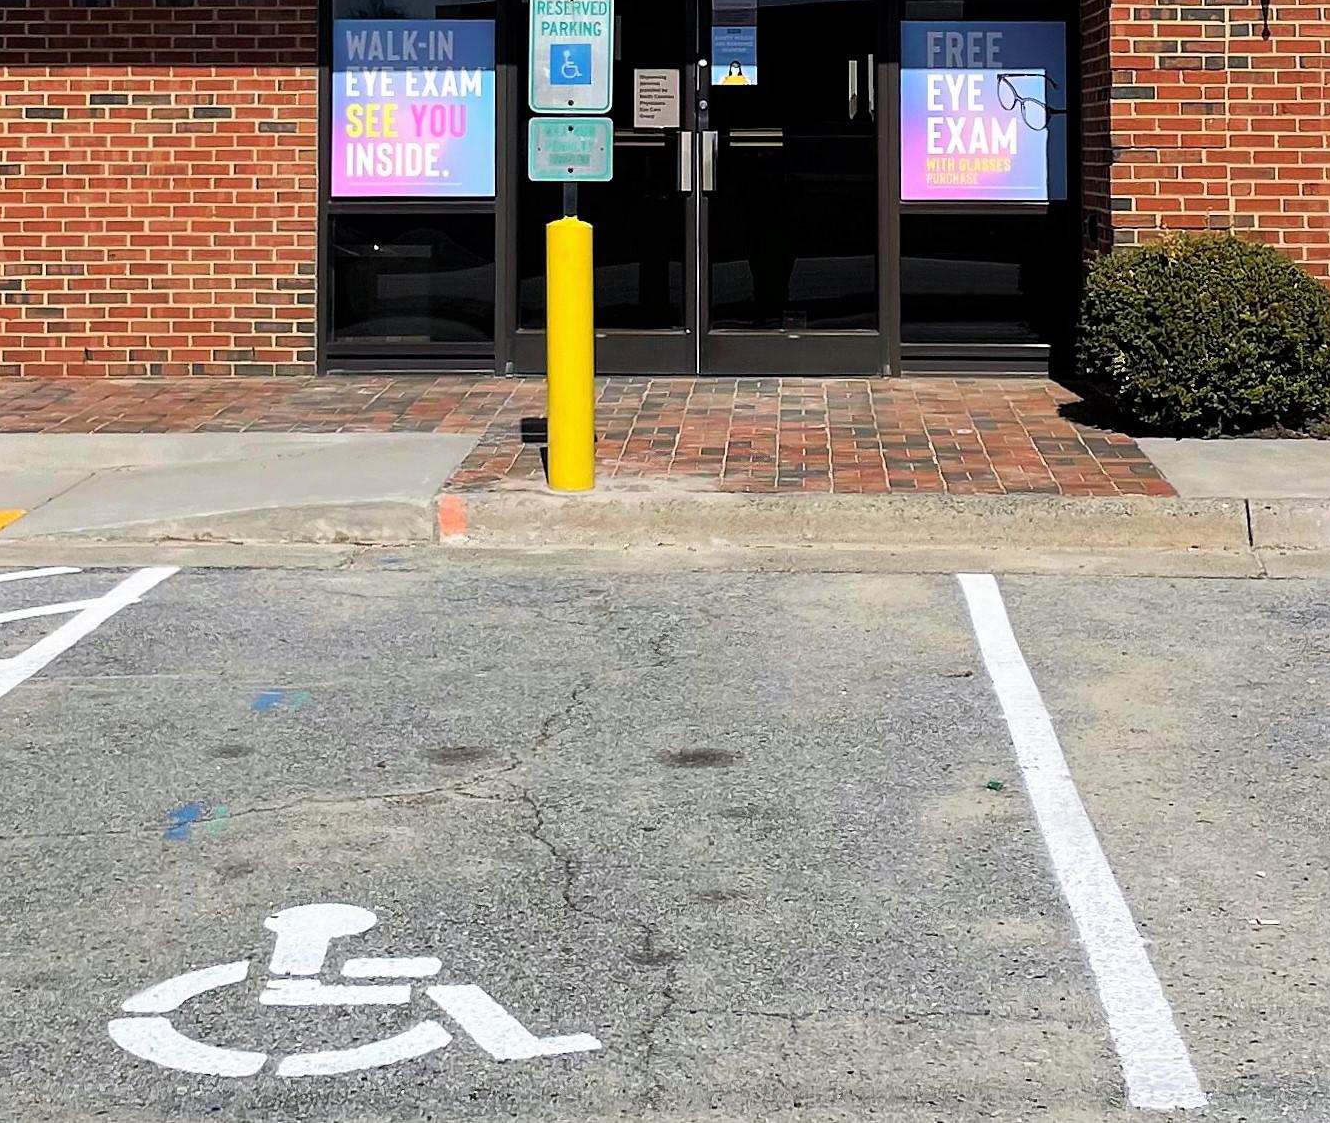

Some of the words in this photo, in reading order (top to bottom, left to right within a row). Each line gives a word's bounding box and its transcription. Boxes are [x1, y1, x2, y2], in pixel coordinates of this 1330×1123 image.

[537, 0, 607, 15] RESERVED
[541, 21, 602, 36] PARKING
[346, 30, 453, 61] WALK-IN
[926, 31, 1003, 68] FREE
[346, 66, 395, 97] EYE
[405, 66, 483, 97] EXAM
[926, 74, 984, 111] EYE
[346, 103, 398, 139] SEE
[410, 103, 466, 138] YOU
[926, 117, 1017, 155] EXAM
[346, 142, 449, 177] INSIDE.
[926, 158, 955, 171] WITH
[958, 158, 1011, 172] GLASSES
[926, 173, 979, 185] PURCHASE
